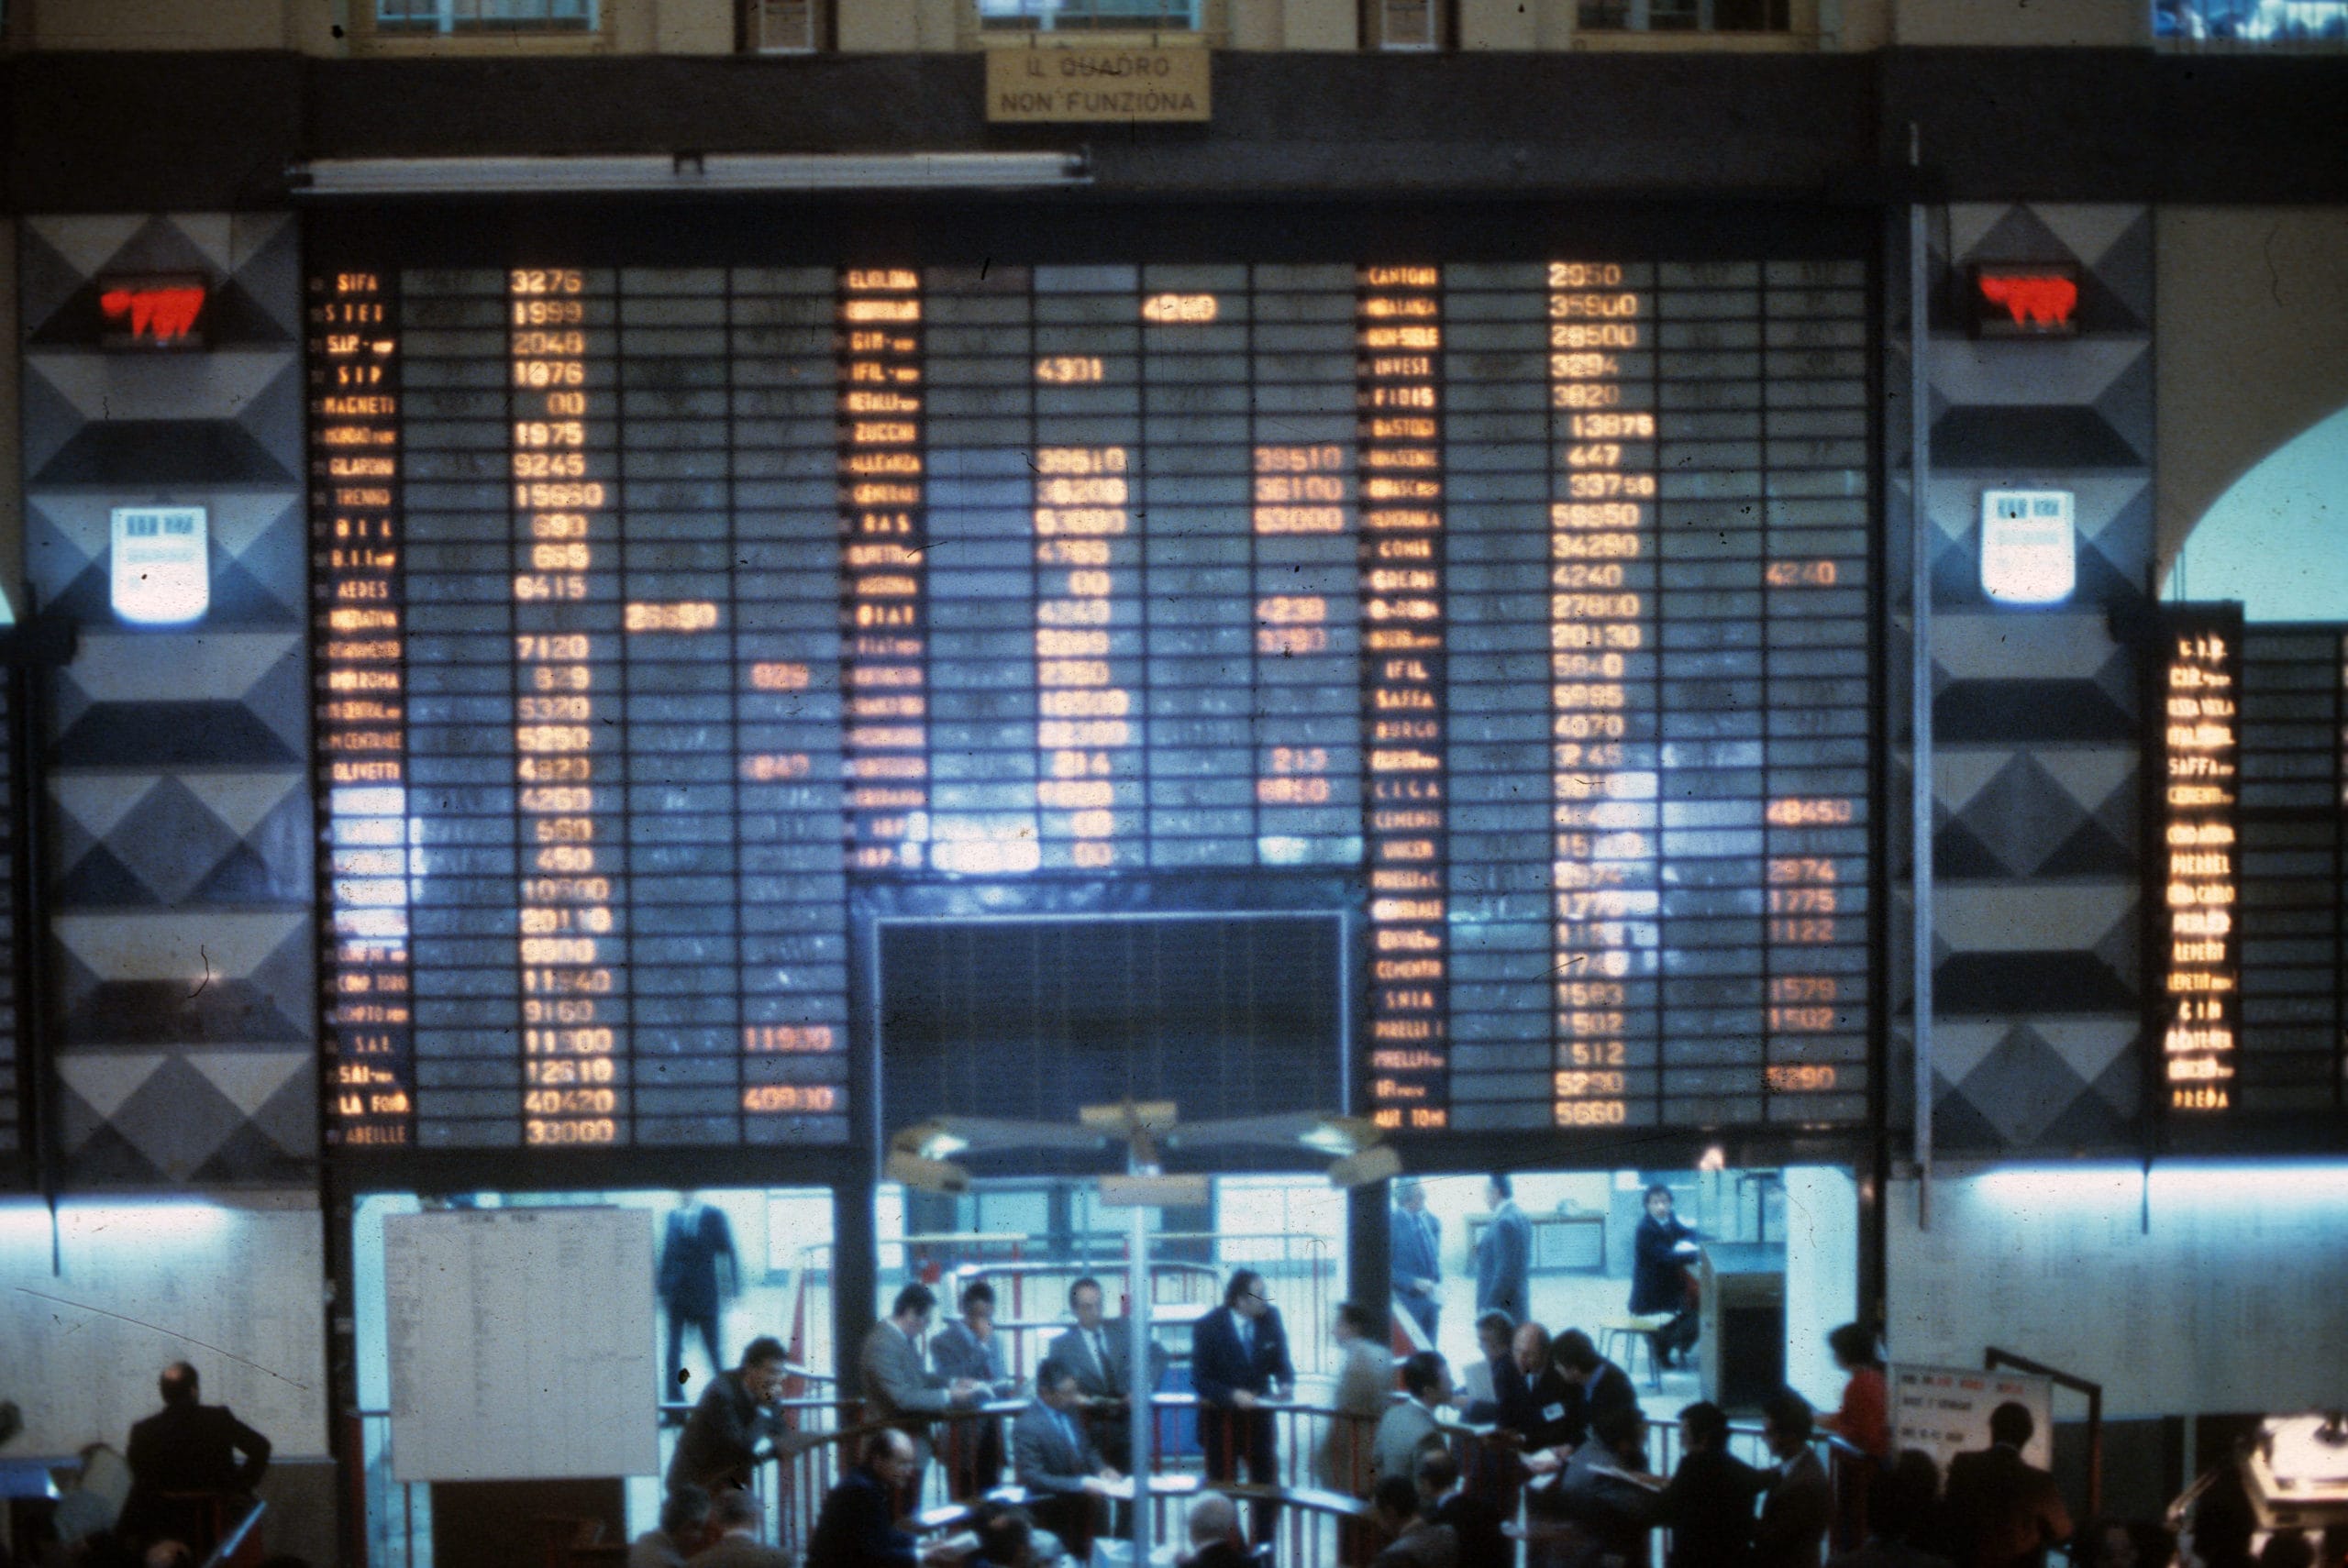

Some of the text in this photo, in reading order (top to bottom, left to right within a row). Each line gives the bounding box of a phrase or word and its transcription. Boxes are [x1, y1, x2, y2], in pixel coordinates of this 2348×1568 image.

[1026, 56, 1170, 77] IL QUADRO
[1001, 92, 1196, 113] NON FUNZIONA
[337, 273, 377, 293] SIFA
[1548, 262, 1620, 288] 2050
[1550, 294, 1637, 317] 35900
[339, 1095, 363, 1115] LA
